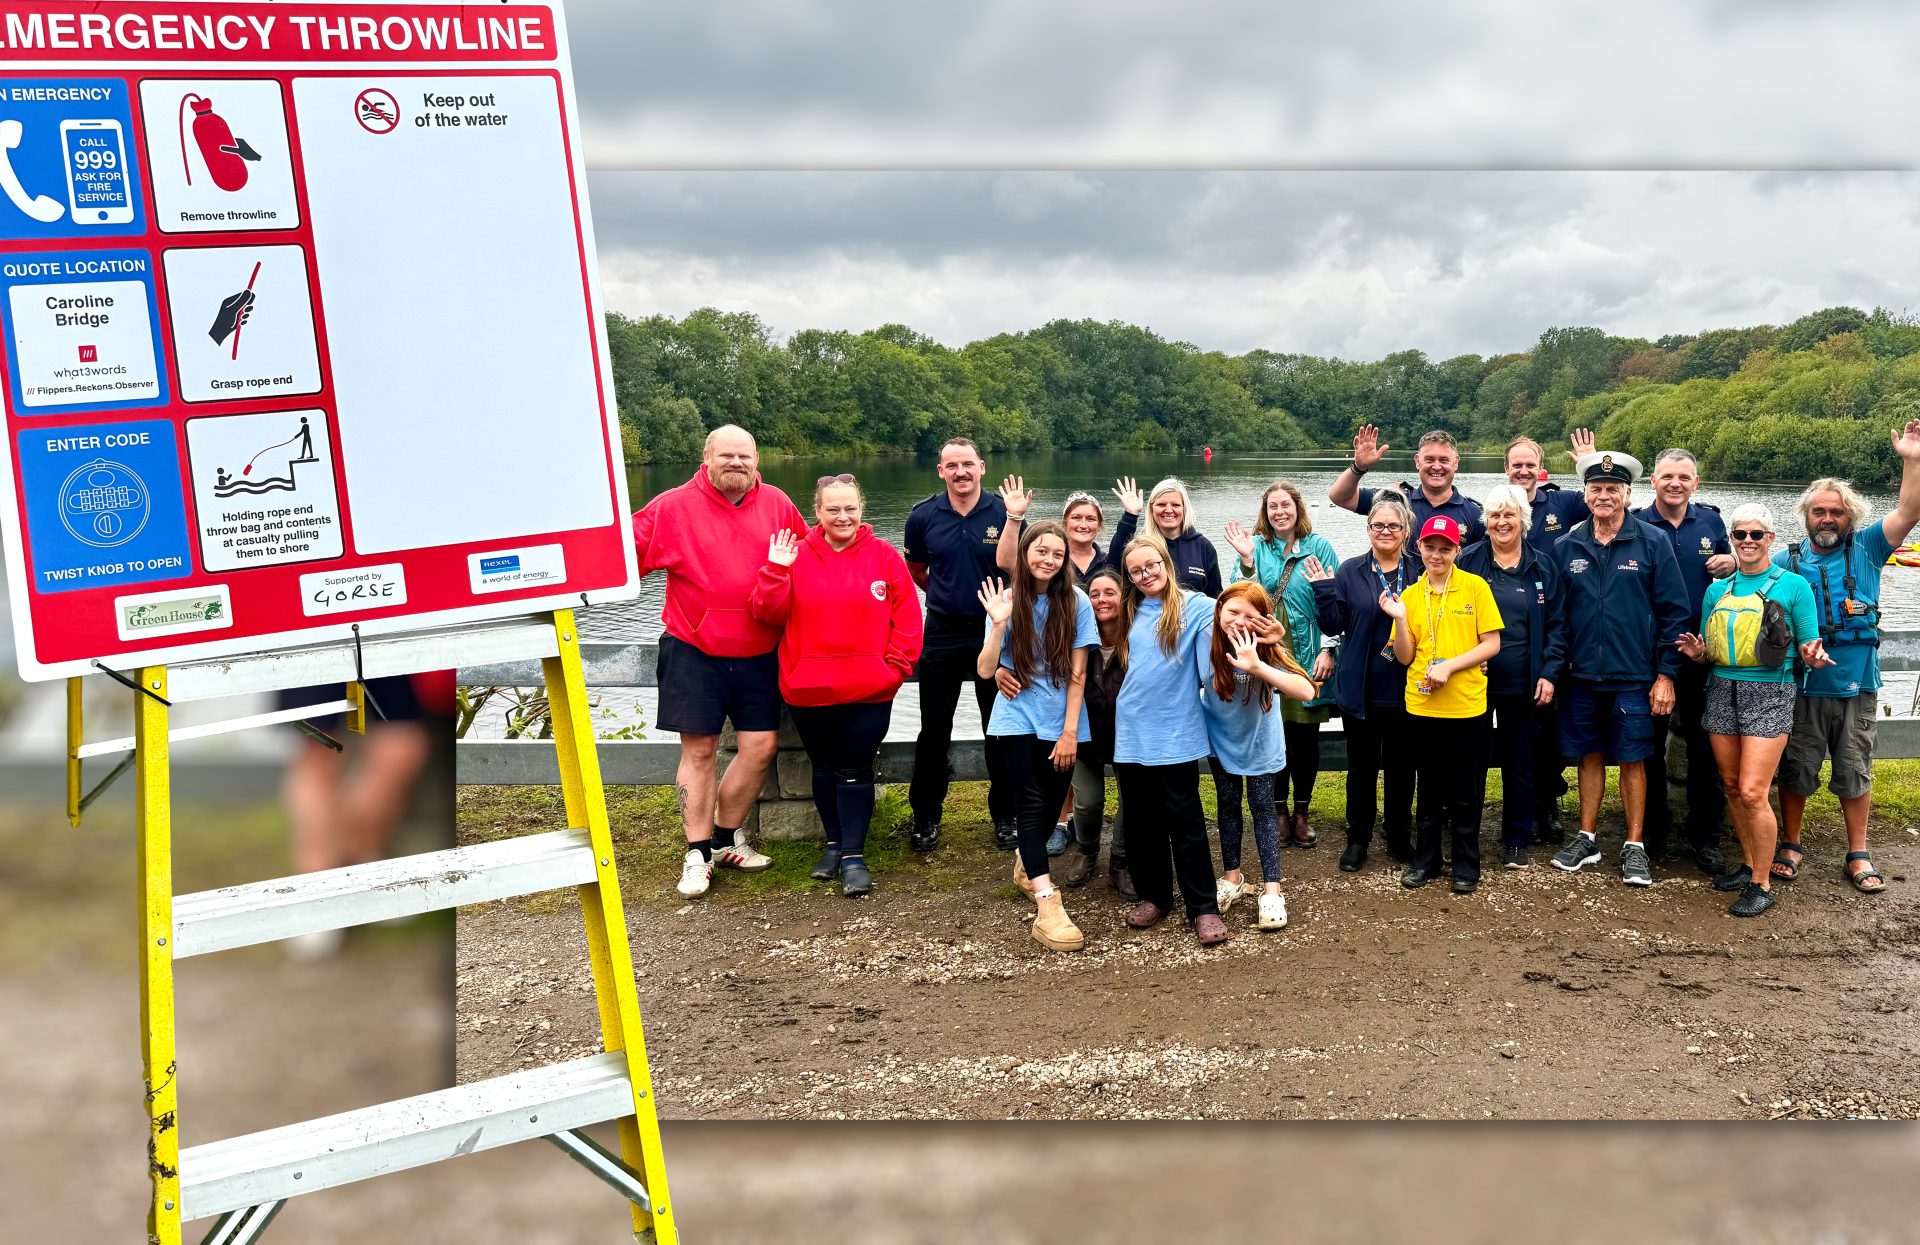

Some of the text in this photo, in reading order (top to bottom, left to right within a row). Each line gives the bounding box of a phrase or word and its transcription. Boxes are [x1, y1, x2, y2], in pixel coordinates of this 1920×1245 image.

[0, 13, 545, 51] MERGENCY THROWLINE
[12, 88, 112, 101] EMERGENCY
[423, 92, 495, 110] Keep out
[414, 112, 508, 127] of the water
[79, 138, 107, 147] CALL
[74, 150, 116, 169] 999
[75, 172, 122, 182] ASK FOR
[87, 182, 111, 192] FIRE
[78, 192, 124, 202] SERVICE
[180, 210, 277, 222] Remove throwline
[3, 259, 146, 277] QUOTE LOCATION
[45, 294, 114, 310] Caroline
[55, 312, 110, 328] Bridge
[54, 364, 127, 378] what3words
[37, 380, 154, 395] Flippers.Reckons.Observer
[210, 375, 293, 391] Grasp rope end
[46, 432, 150, 452] ENTER CODE
[222, 504, 313, 522] Holding rope end
[206, 515, 332, 536] throw bag and contents
[223, 530, 319, 548] at casualty pulling
[236, 543, 310, 559] them to shore
[44, 557, 183, 582] TWIST KNOB TO OPEN
[489, 574, 512, 584] world
[523, 570, 549, 579] energy
[324, 572, 382, 586] Supported by
[314, 582, 396, 608] GORSE
[129, 610, 204, 628] Green House
